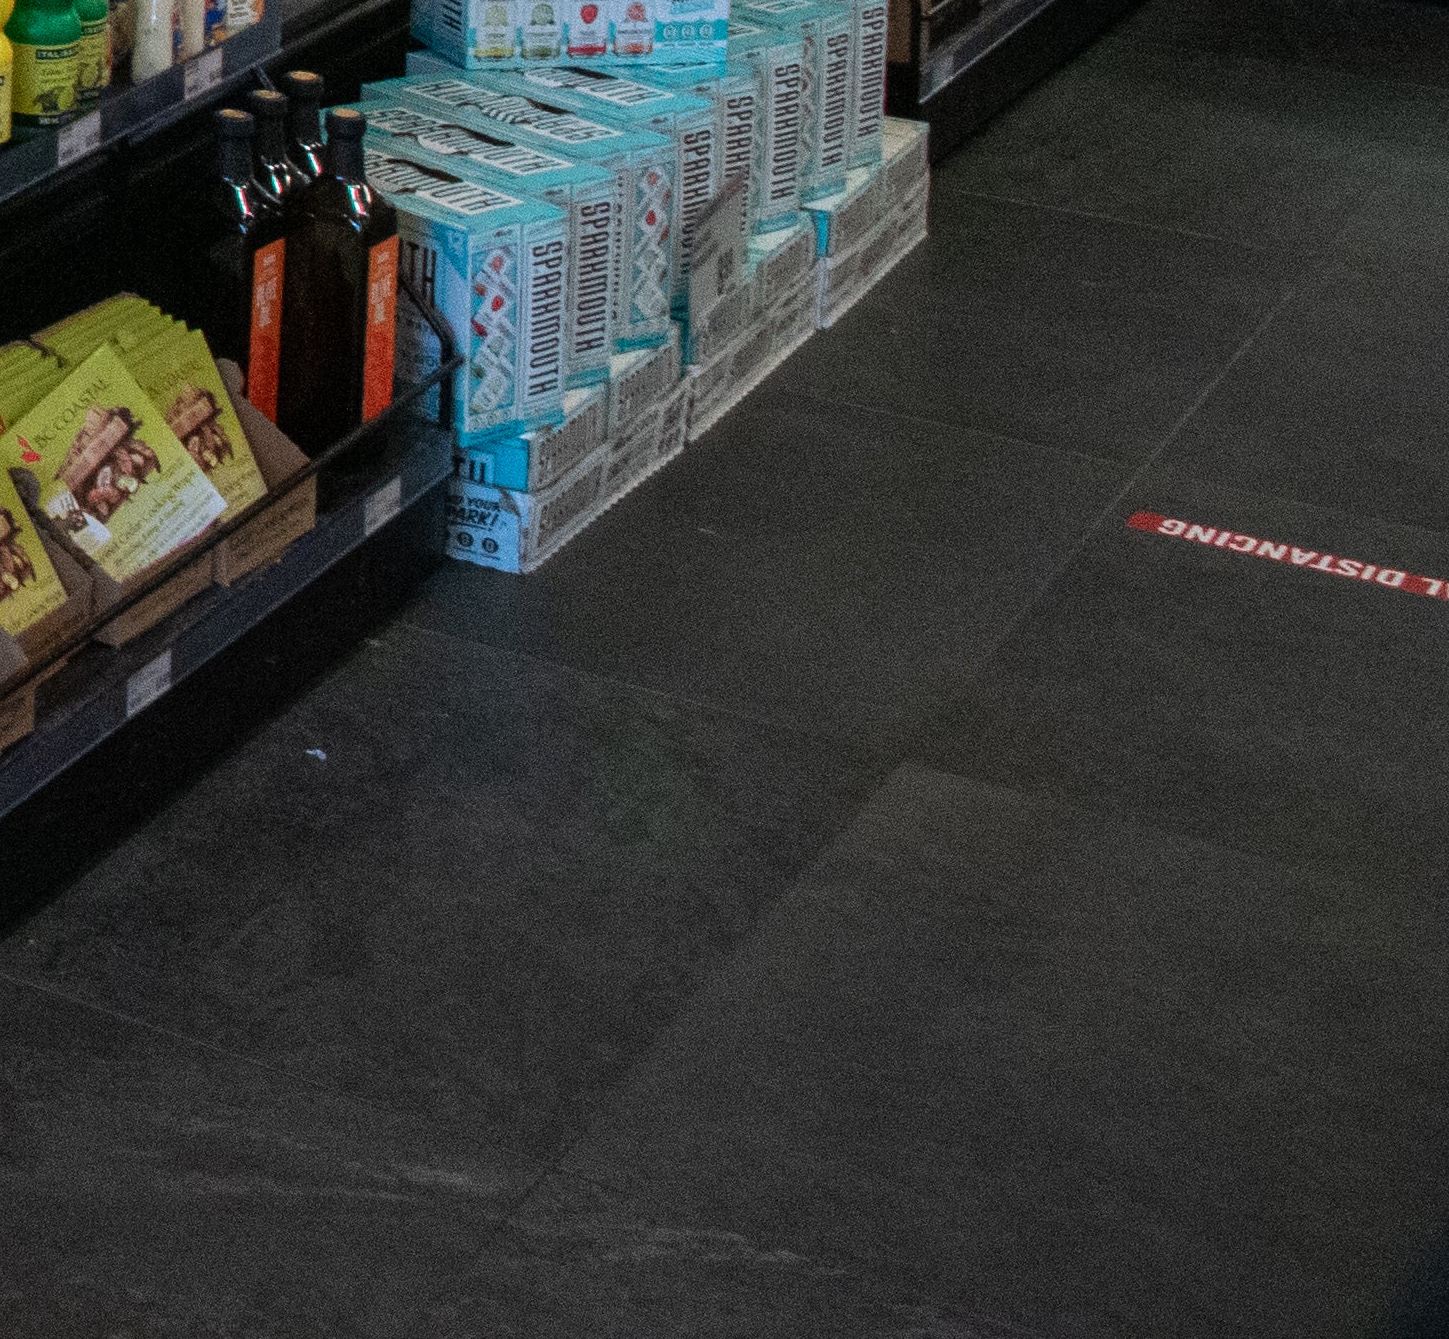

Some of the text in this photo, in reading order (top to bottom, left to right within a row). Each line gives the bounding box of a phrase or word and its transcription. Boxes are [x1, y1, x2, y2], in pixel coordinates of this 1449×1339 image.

[530, 240, 565, 398] SPARKMOUTH
[578, 201, 612, 354] SPARKMOUTH
[1156, 518, 1407, 589] DISTANCING
